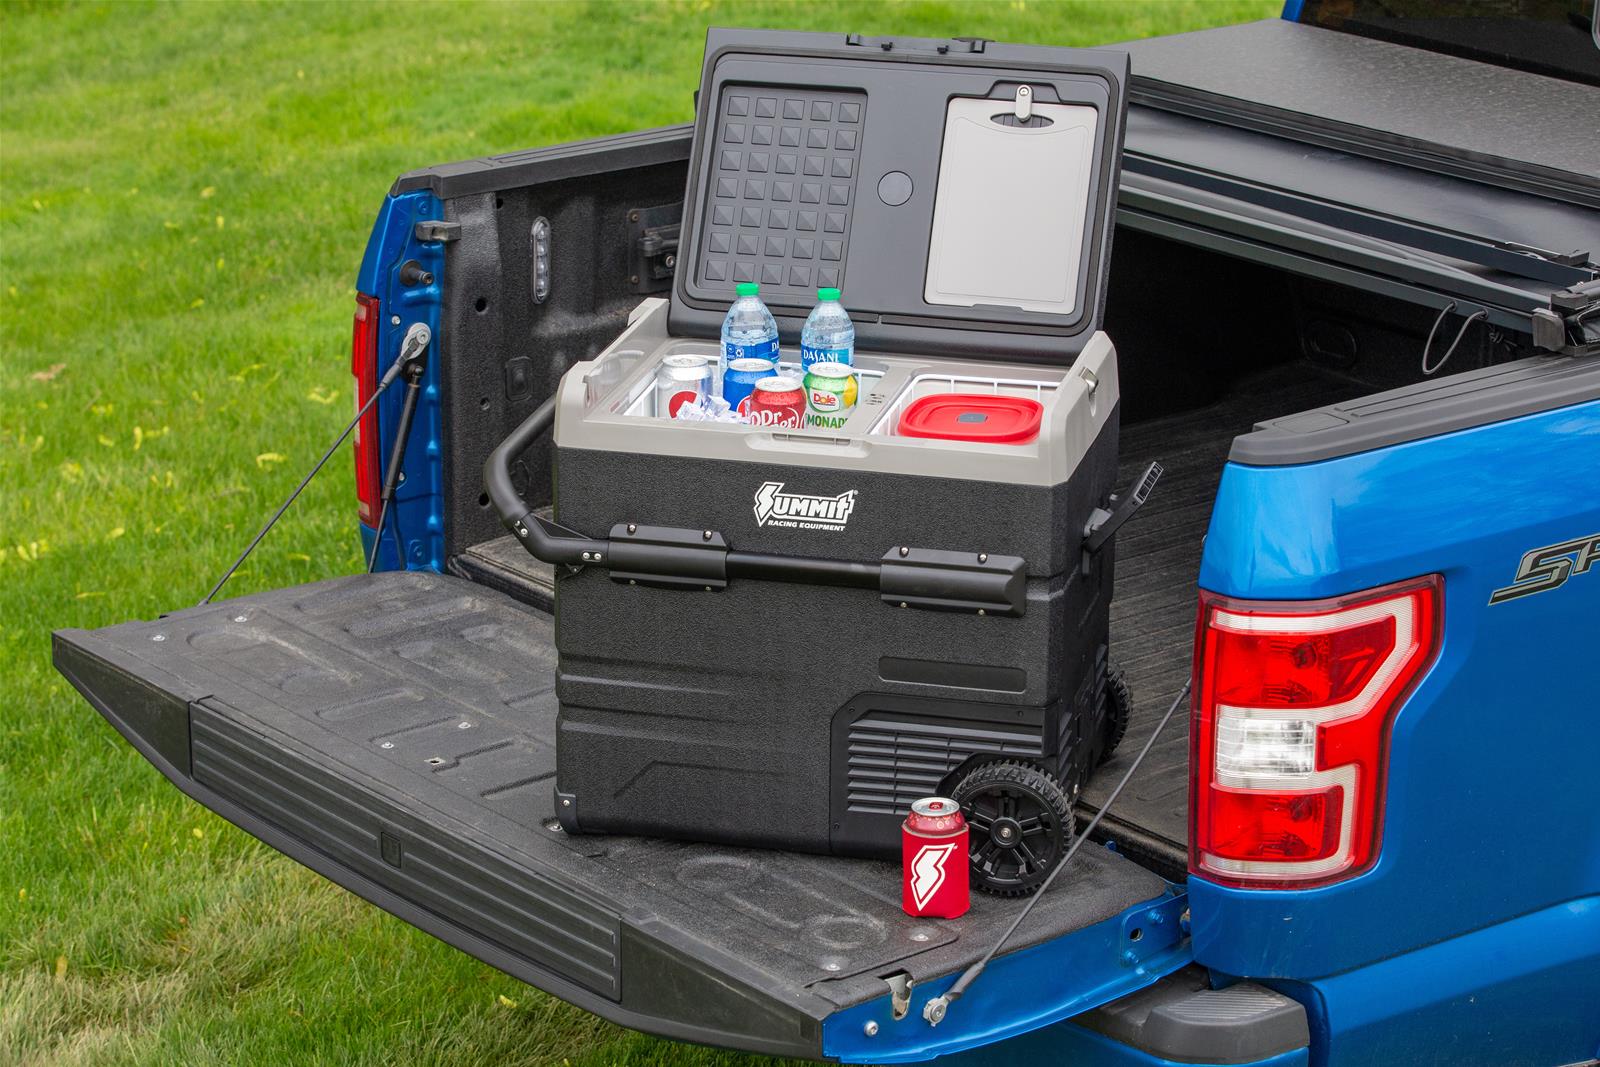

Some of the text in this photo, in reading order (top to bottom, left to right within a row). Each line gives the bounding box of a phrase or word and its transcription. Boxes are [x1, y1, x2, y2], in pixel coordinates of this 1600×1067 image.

[803, 349, 839, 363] DASANI
[813, 392, 836, 404] Dole
[805, 413, 848, 429] MONAD
[767, 520, 845, 531] RACING EQUIPMENT
